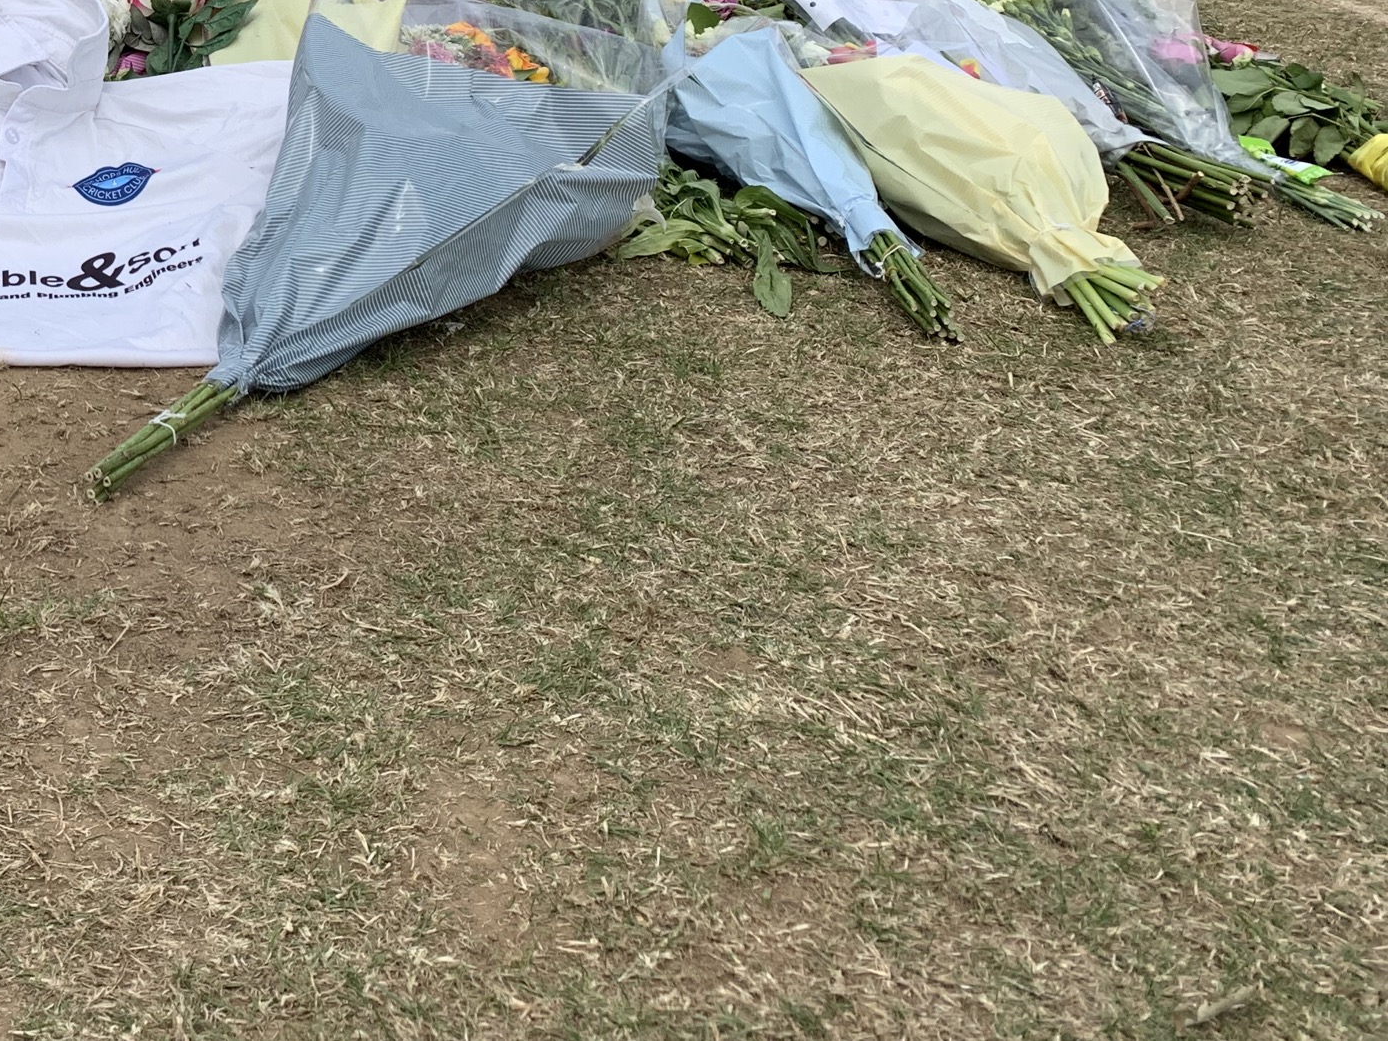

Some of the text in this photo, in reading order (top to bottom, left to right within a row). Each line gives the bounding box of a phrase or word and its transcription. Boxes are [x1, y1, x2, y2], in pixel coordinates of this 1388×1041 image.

[82, 185, 122, 200] CRICKET
[36, 291, 119, 300] Plumbing
[123, 255, 204, 294] Engineers
[65, 251, 126, 291] &
